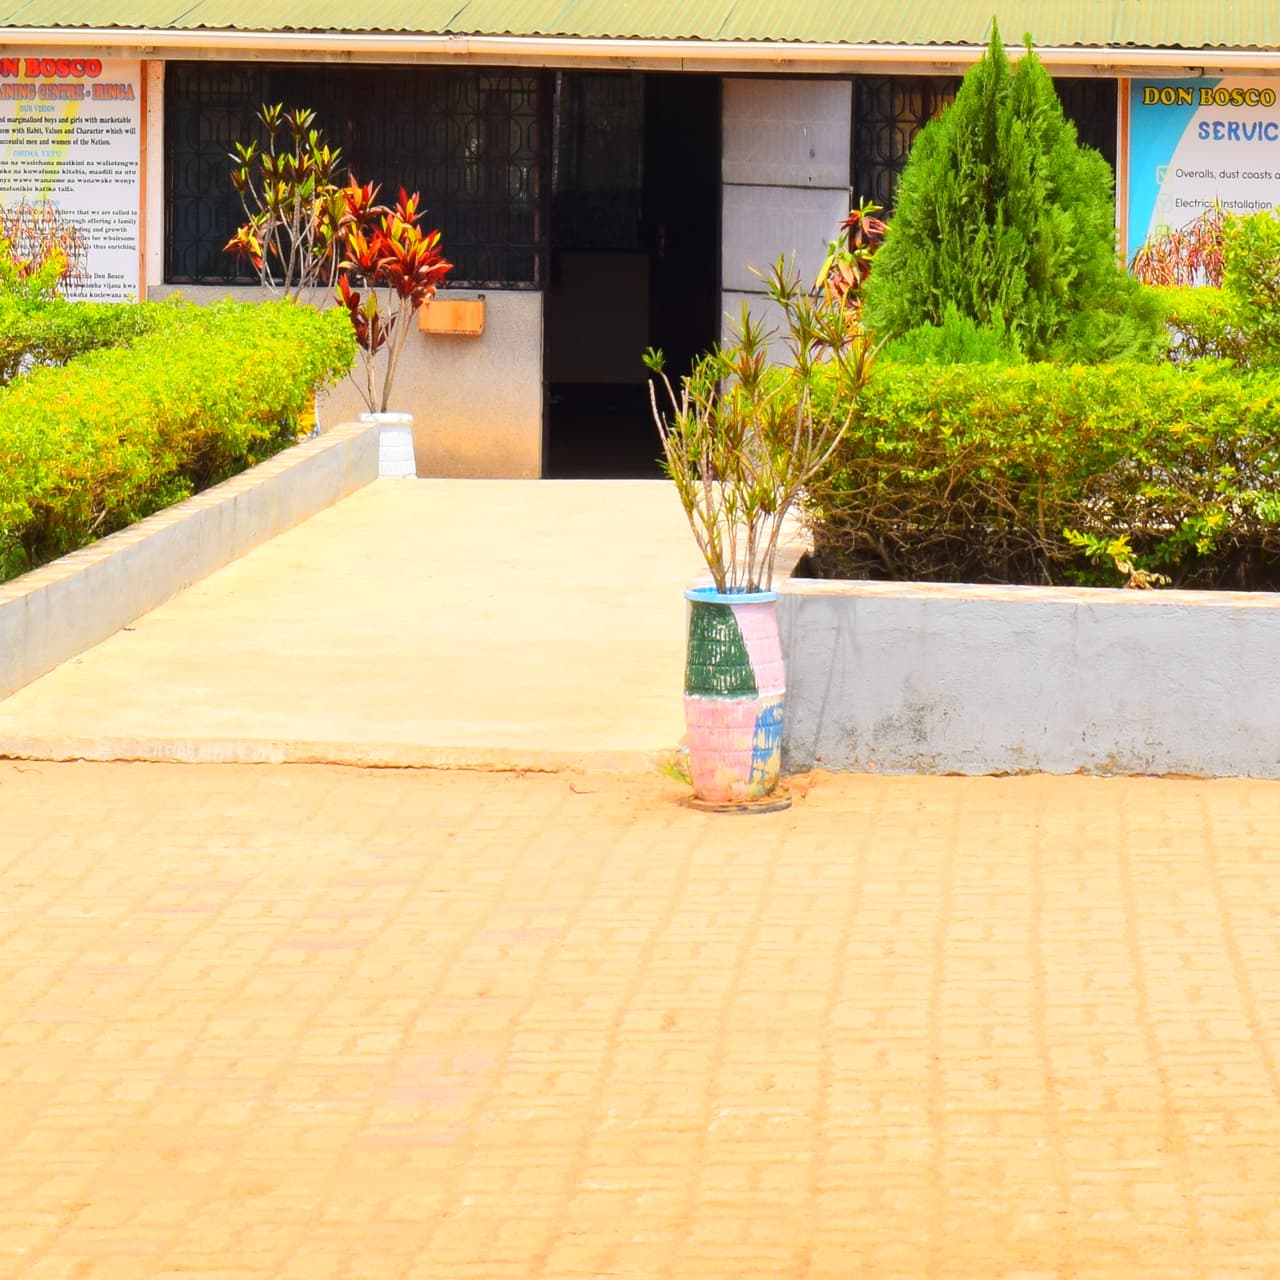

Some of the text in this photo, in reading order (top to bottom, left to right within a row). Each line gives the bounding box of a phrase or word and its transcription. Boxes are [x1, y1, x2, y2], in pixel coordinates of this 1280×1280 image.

[24, 58, 103, 78] BOSCO
[38, 83, 85, 101] CENTRE
[92, 83, 136, 101] IRINGA
[1143, 86, 1193, 106] DON
[1198, 87, 1276, 108] BOSCO
[44, 116, 57, 125] boys
[59, 116, 69, 124] and
[70, 116, 83, 126] girls
[84, 116, 98, 124] with
[99, 116, 131, 124] marketable
[12, 126, 25, 134] with
[45, 126, 63, 135] Values
[64, 126, 75, 135] and
[76, 126, 104, 135] Character
[105, 126, 123, 135] which
[125, 126, 136, 135] will
[39, 137, 49, 145] and
[73, 137, 79, 145] of
[80, 137, 89, 145] the
[1176, 168, 1216, 180] Overalls,
[1219, 169, 1239, 179] dust
[1242, 170, 1272, 180] coasts
[1175, 199, 1272, 209] Electrica Installation
